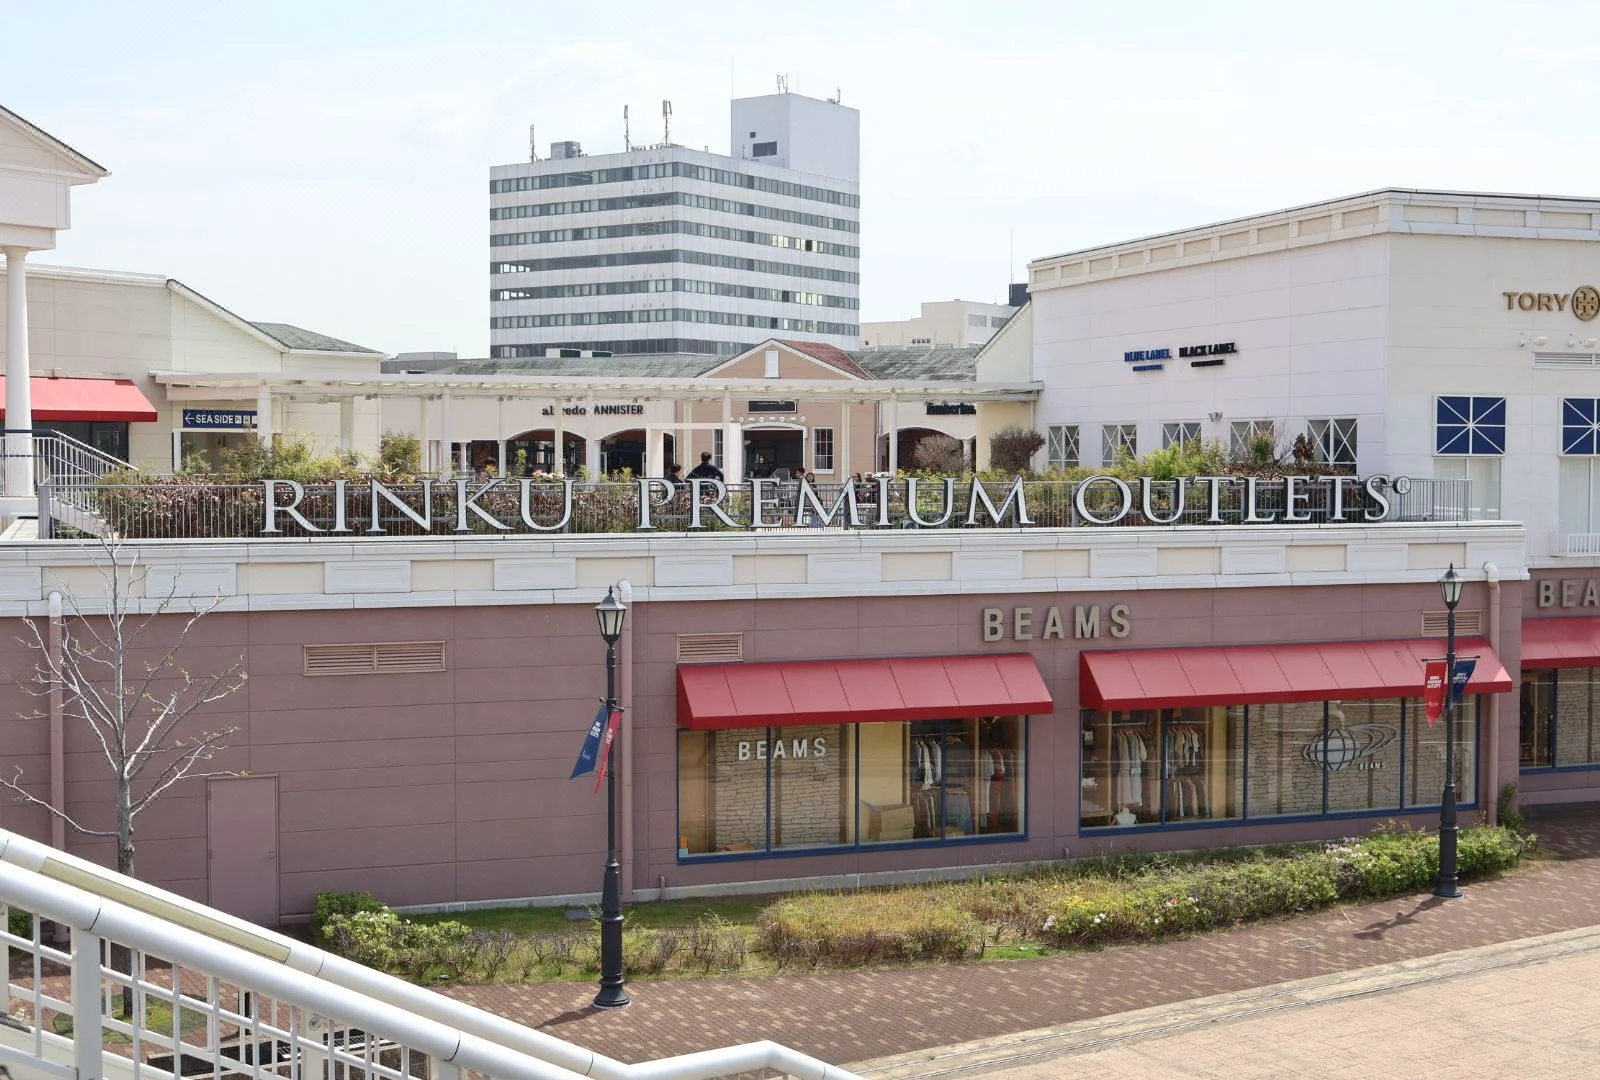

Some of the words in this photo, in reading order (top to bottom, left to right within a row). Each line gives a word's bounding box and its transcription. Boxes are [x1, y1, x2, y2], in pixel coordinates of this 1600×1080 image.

[1502, 291, 1570, 312] TORY
[1124, 350, 1145, 362] BLUE
[1146, 348, 1172, 360] LABEL
[1179, 345, 1207, 358] BLACK
[1208, 342, 1237, 355] LABEL
[593, 404, 644, 415] ANNISTER
[258, 477, 580, 533] RINKU
[635, 474, 1036, 529] PREMIUM
[1537, 579, 1600, 608] BEA
[983, 603, 1131, 642] BEAMS
[738, 737, 826, 761] BEAMS
[1359, 761, 1386, 771] BEAMS
